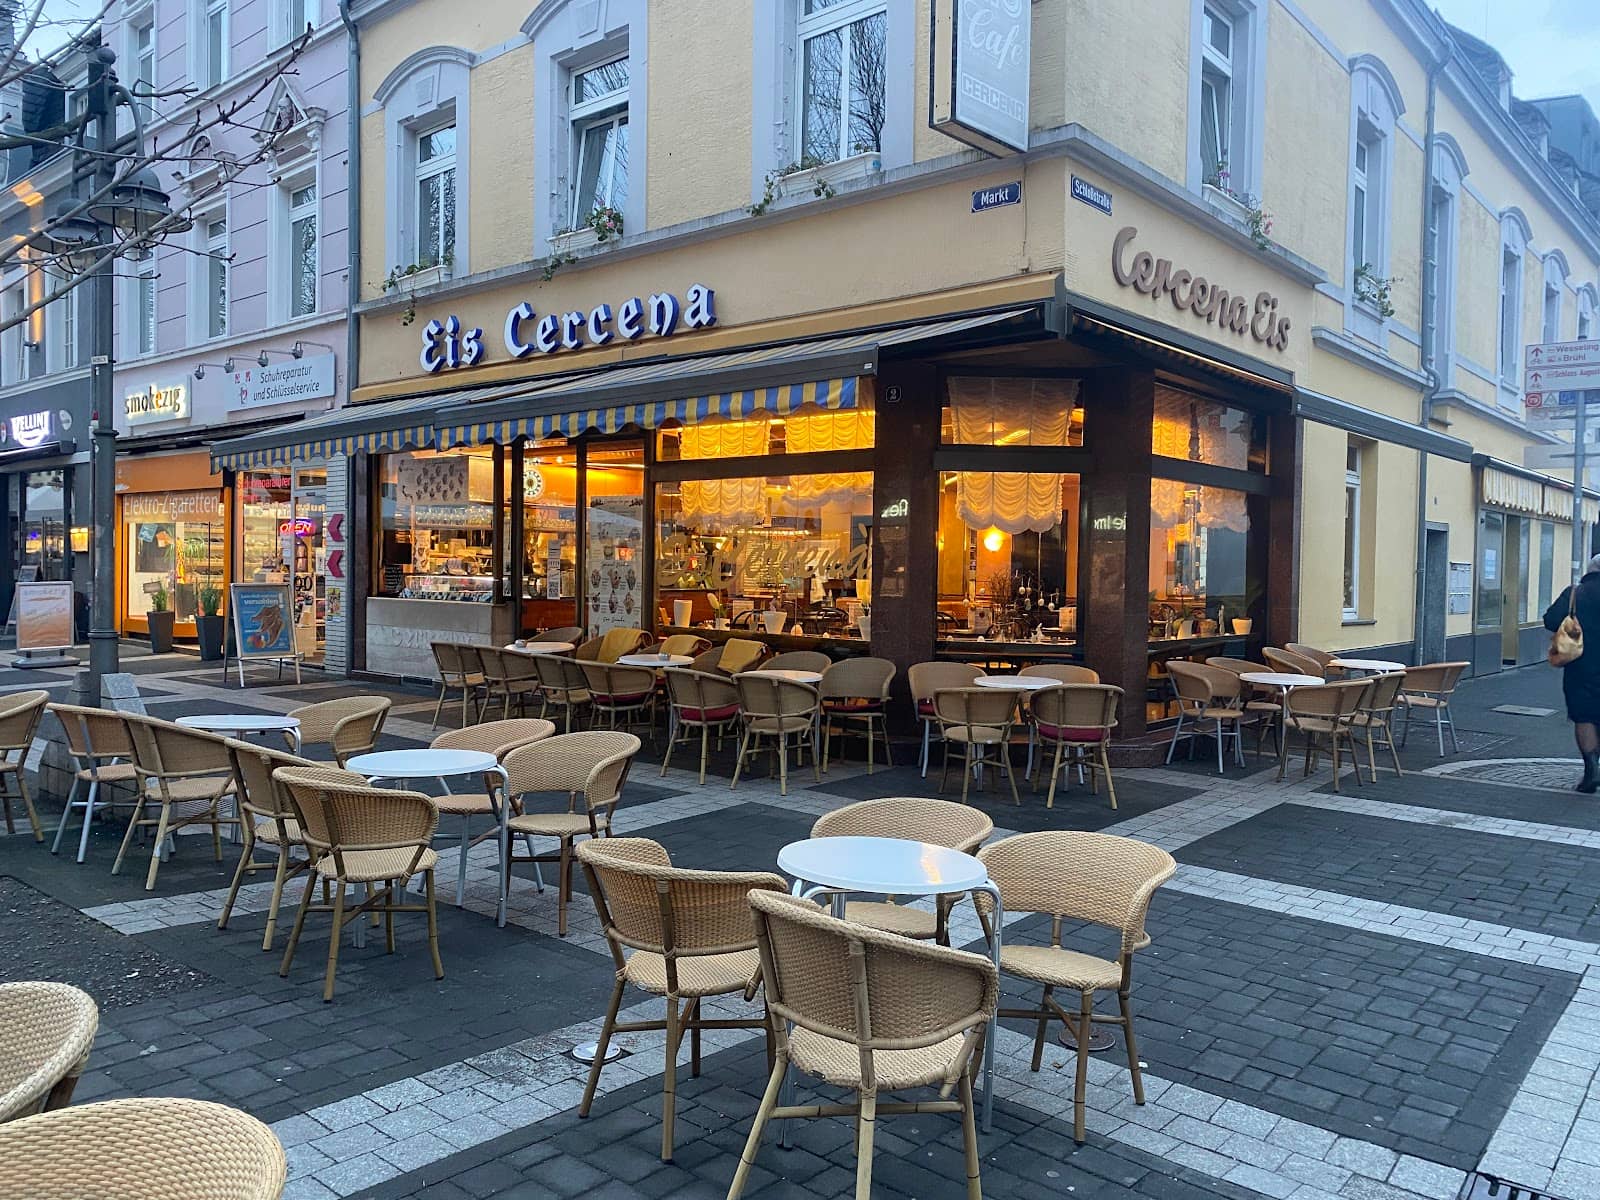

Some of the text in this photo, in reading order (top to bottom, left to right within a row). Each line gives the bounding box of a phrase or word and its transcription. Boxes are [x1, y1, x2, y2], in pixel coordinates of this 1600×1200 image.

[963, 76, 1024, 120] CERCENA
[981, 188, 1009, 206] Markt
[1112, 226, 1292, 352] Cercena Eis
[419, 283, 717, 373] Eis Cercena
[260, 364, 313, 384] Schuhreparatur
[124, 386, 182, 415] smokezig
[253, 381, 320, 401] und Schlüsselservice
[889, 388, 897, 400] 2
